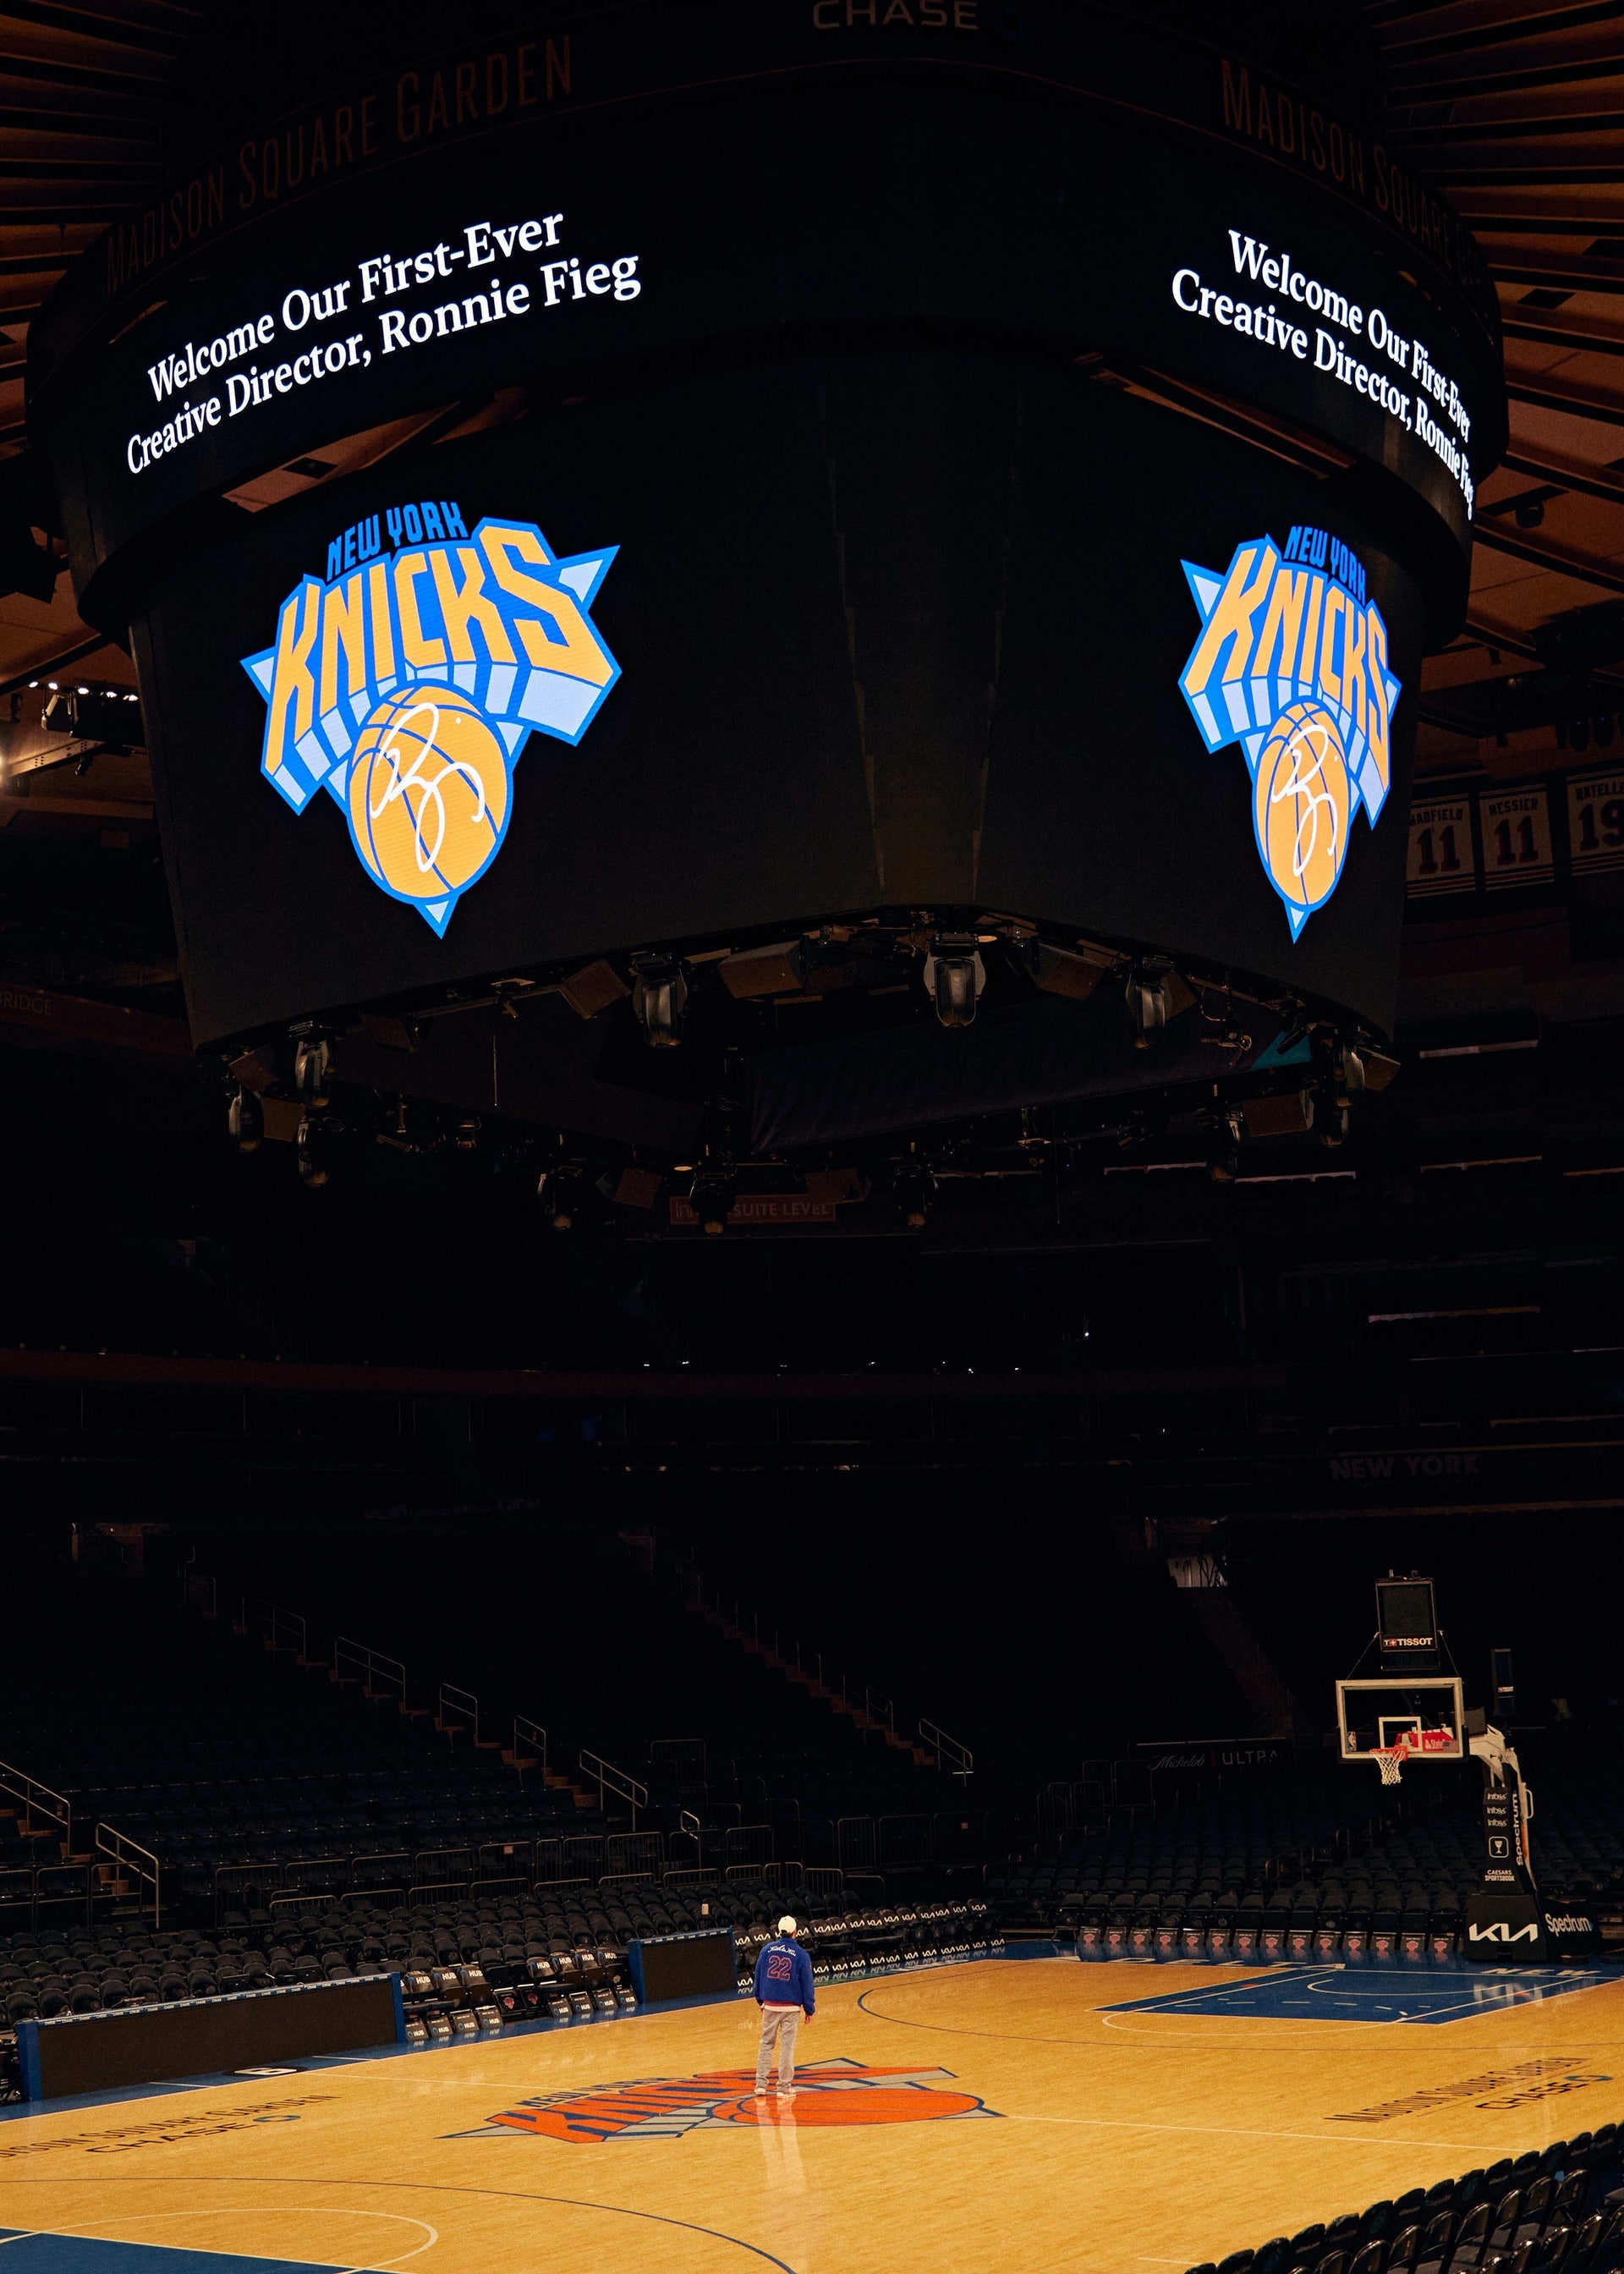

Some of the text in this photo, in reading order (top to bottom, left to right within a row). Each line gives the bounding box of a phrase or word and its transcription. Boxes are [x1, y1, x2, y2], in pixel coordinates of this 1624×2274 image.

[812, 0, 980, 31] CHASE
[1221, 57, 1366, 197] MADISON
[105, 33, 573, 299] MADISON SQUARE GARDEN
[146, 212, 564, 403] Welcome Our First-Ever
[1228, 228, 1363, 336] Welcome
[1368, 309, 1410, 368] Our
[1412, 339, 1471, 443] First-Ever
[127, 255, 642, 475] Creative Director, Ronnie Fieg
[1171, 268, 1309, 360] Creative
[1314, 327, 1413, 431] Director,
[1416, 397, 1460, 480] Ronnie
[326, 501, 469, 582] NEW YORK
[1283, 525, 1367, 603] NEW YORK
[265, 525, 615, 777] KNICKS
[1183, 544, 1390, 793] KNICKS
[1489, 798, 1539, 816] MESSIER
[1575, 781, 1624, 800] RATELLE
[1417, 825, 1461, 875] 11
[1495, 815, 1539, 865] 11
[1577, 799, 1624, 851] 19
[733, 1202, 831, 1217] SUITE LEVEL
[1330, 1453, 1481, 1481] NEW YORK
[1396, 1637, 1434, 1647] TISSOT
[1512, 1793, 1523, 1866] Spectrum
[1468, 1922, 1539, 1942] KIA
[1544, 1913, 1593, 1937] Spectrum
[767, 1954, 793, 1981] 22
[78, 2115, 223, 2139] SQUARE
[205, 2095, 343, 2117] GARDEN
[1475, 2082, 1589, 2109] CHASE
[85, 2123, 257, 2153] CHASE
